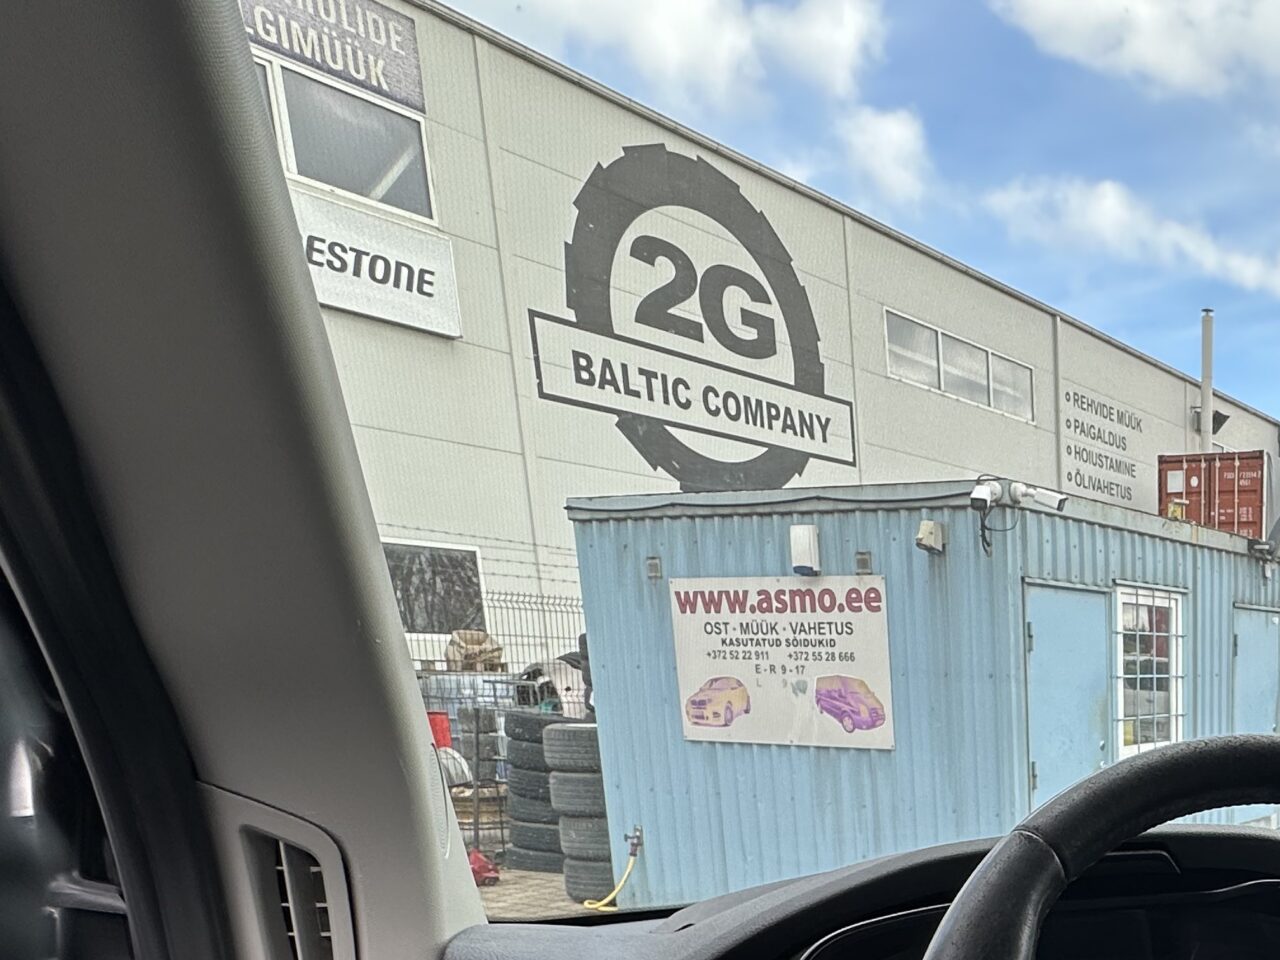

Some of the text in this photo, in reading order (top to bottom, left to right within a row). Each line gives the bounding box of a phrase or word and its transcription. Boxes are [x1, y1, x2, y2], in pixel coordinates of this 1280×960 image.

[630, 235, 777, 360] 2G
[572, 349, 831, 443] BALTIC COMPANY
[1073, 392, 1142, 433] REHVIDE MÜÜK
[1073, 418, 1127, 452] PAIGALDUS
[1074, 445, 1136, 479] HOIUSTAMINE
[1074, 469, 1132, 501] ÕLIVAHETUS
[674, 587, 882, 614] www.asmo.ee
[704, 619, 854, 636] OST MÜÜK VAHETUS
[721, 635, 836, 648] KASUTATUD SÕIDUKID
[706, 650, 769, 661] +372 52 22 911
[787, 651, 856, 662] +372 55 28 666
